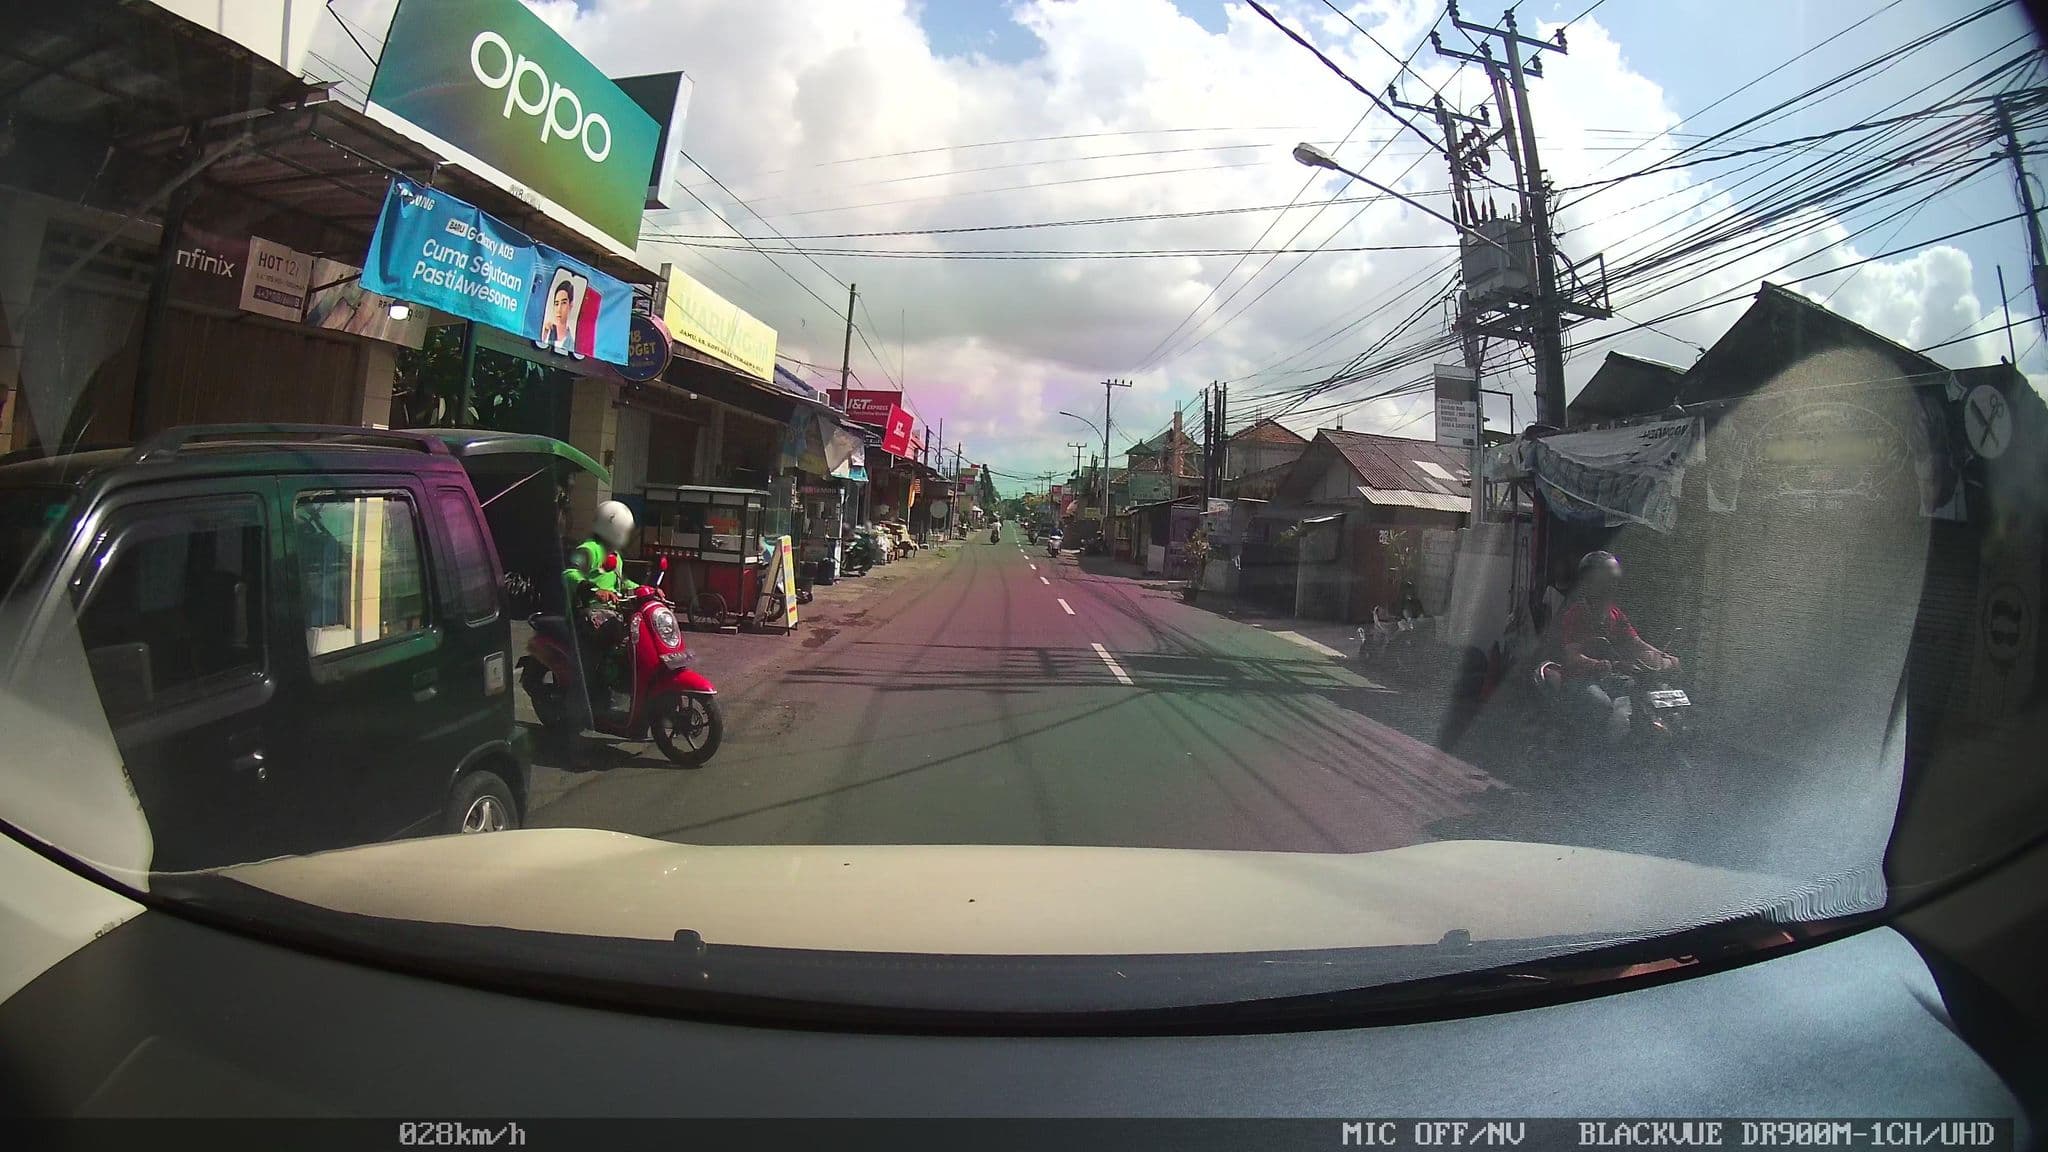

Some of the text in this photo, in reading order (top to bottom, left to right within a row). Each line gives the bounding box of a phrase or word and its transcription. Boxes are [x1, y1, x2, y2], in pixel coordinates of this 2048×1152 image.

[471, 31, 611, 162] oppo
[176, 248, 235, 278] nfinix
[258, 251, 283, 272] HOT
[467, 226, 498, 256] Galaxy
[498, 242, 514, 260] A03
[413, 261, 518, 313] PastiAwesome
[423, 238, 522, 293] Cuma Sejutaan
